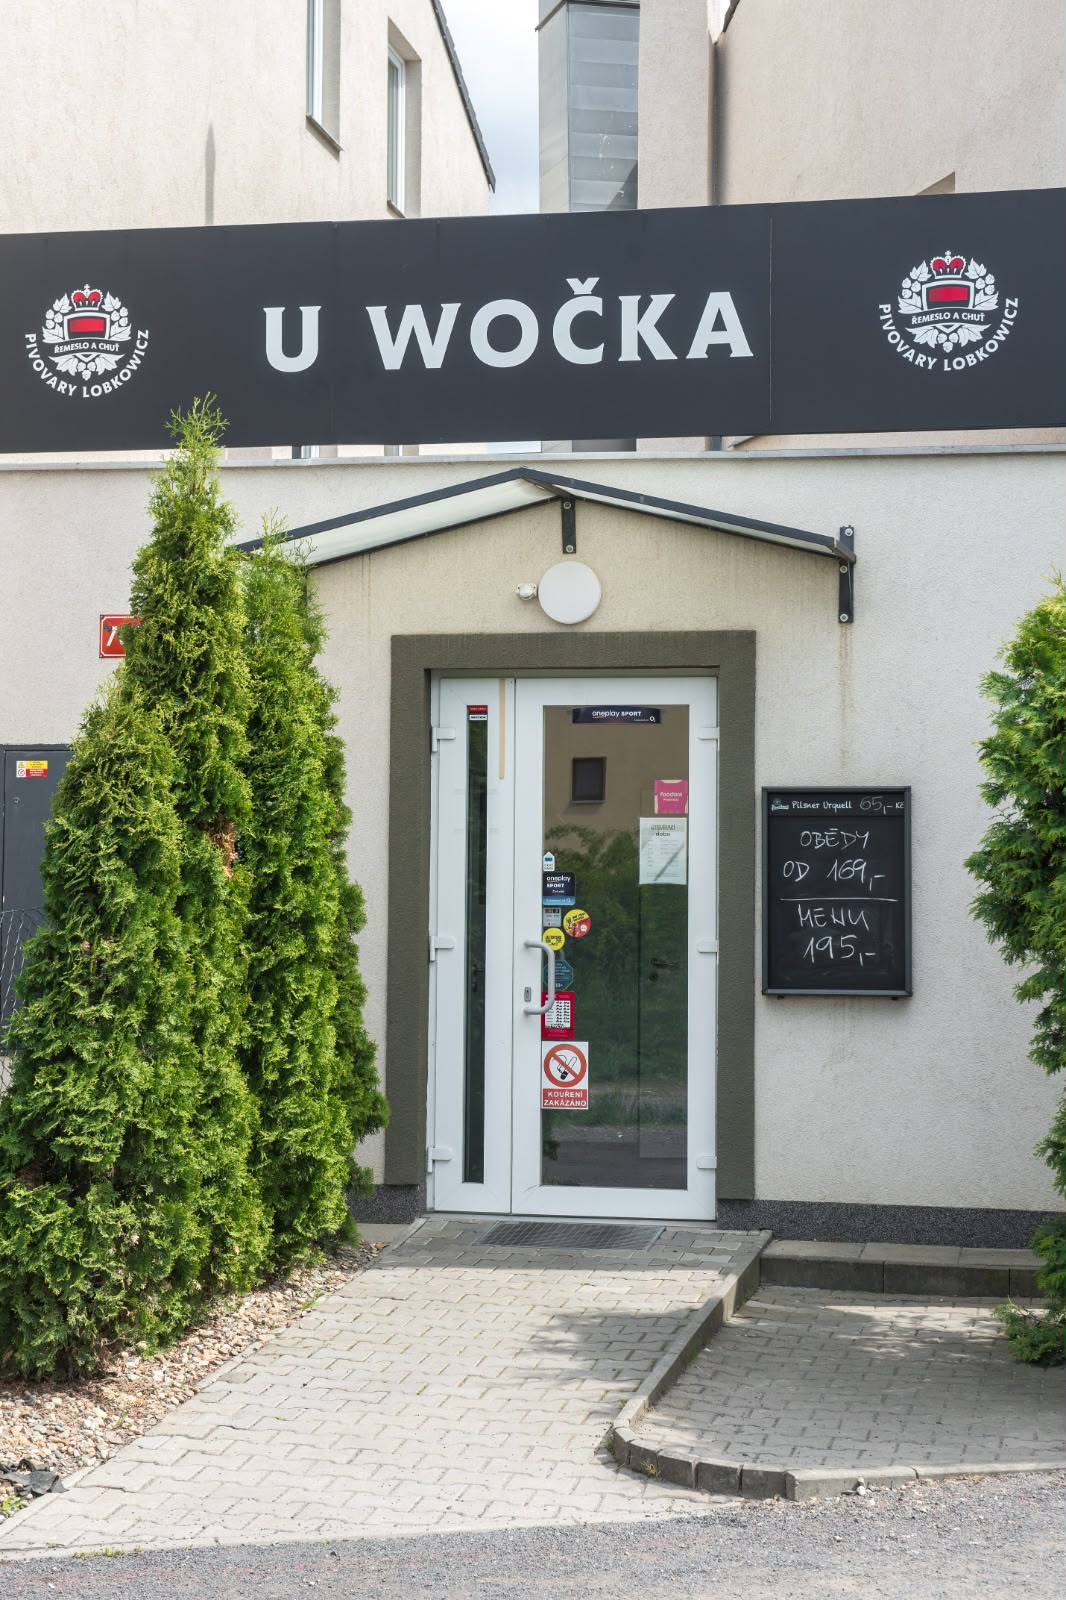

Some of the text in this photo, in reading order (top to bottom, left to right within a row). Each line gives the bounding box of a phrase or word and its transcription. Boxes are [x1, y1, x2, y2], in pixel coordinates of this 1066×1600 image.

[911, 312, 951, 324] ŘEMESLO
[961, 312, 985, 322] CHUŤ
[263, 277, 753, 372] U WOČKA
[879, 298, 1019, 371] PIVOVARY LOBKOWICZ
[54, 342, 120, 354] ŘEMESLO A CHUŤ
[25, 329, 149, 398] PIVOVARY LOBKOWICZ
[592, 710, 620, 718] oneplay
[791, 801, 820, 809] Pilsner
[823, 801, 852, 813] Urquell
[783, 861, 810, 882] OD
[798, 904, 870, 932] MENU
[547, 1090, 583, 1098] KOUŘENÍ
[543, 1098, 587, 1107] ZAKÁZÁNO
